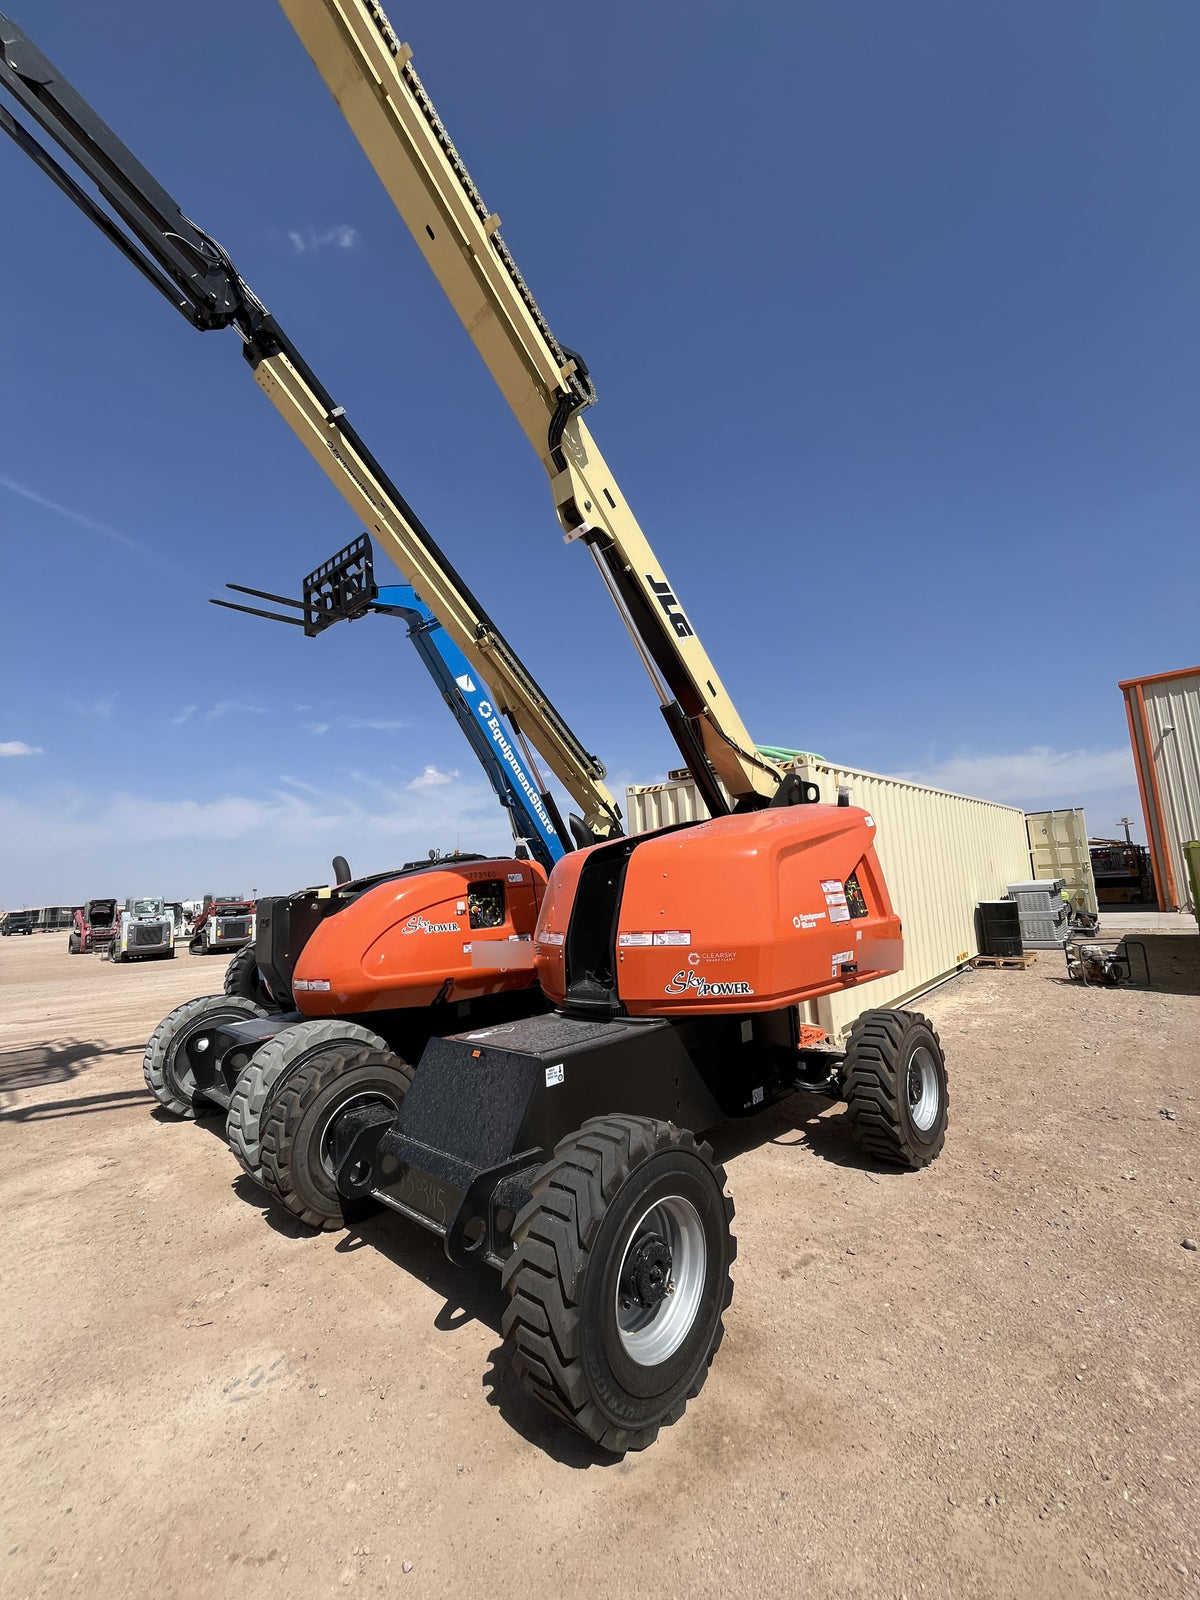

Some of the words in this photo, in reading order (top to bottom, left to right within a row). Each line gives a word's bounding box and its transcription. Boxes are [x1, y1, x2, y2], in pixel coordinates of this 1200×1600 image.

[644, 573, 694, 638] JLG
[487, 717, 555, 835] EquipmentShare
[401, 916, 430, 934] Sky
[428, 922, 459, 932] POWER
[799, 911, 827, 921] Equipment
[801, 920, 817, 929] Share
[664, 970, 706, 997] Sky
[703, 982, 750, 995] POWER
